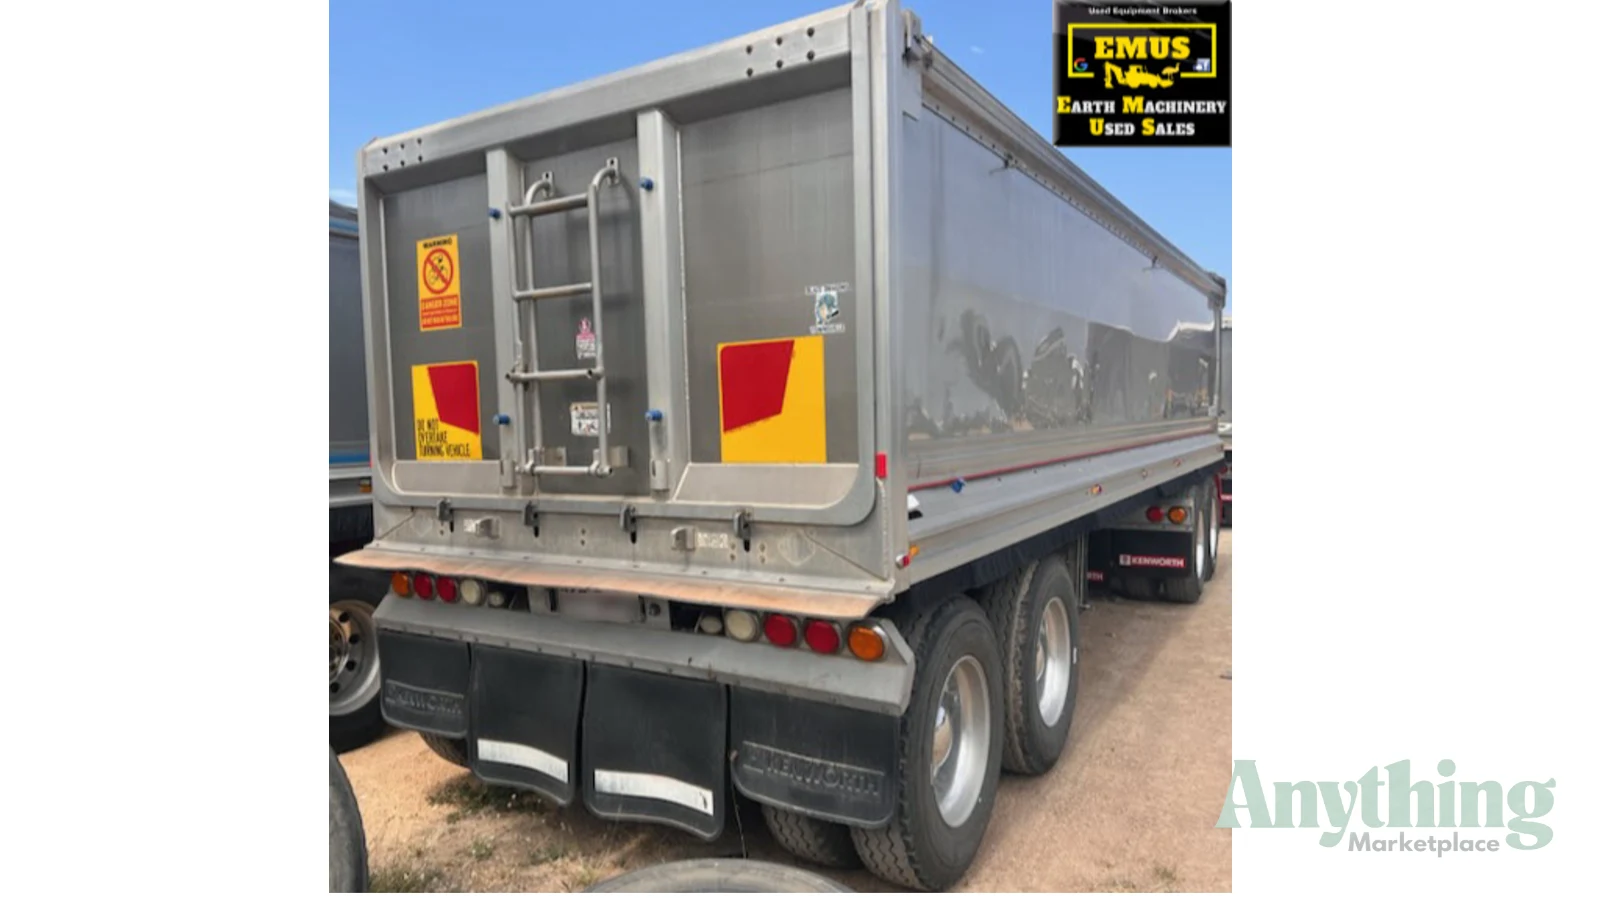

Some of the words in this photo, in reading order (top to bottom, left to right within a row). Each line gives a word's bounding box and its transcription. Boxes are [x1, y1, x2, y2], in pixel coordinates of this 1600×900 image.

[423, 237, 453, 249] WARNING
[417, 418, 425, 431] DO
[427, 418, 439, 431] NOT
[418, 430, 447, 444] OVERTAKE
[419, 442, 444, 457] TURNING
[445, 443, 470, 457] VEHICLE
[1131, 556, 1185, 567] KENWORTH
[765, 750, 881, 796] KENWORTH
